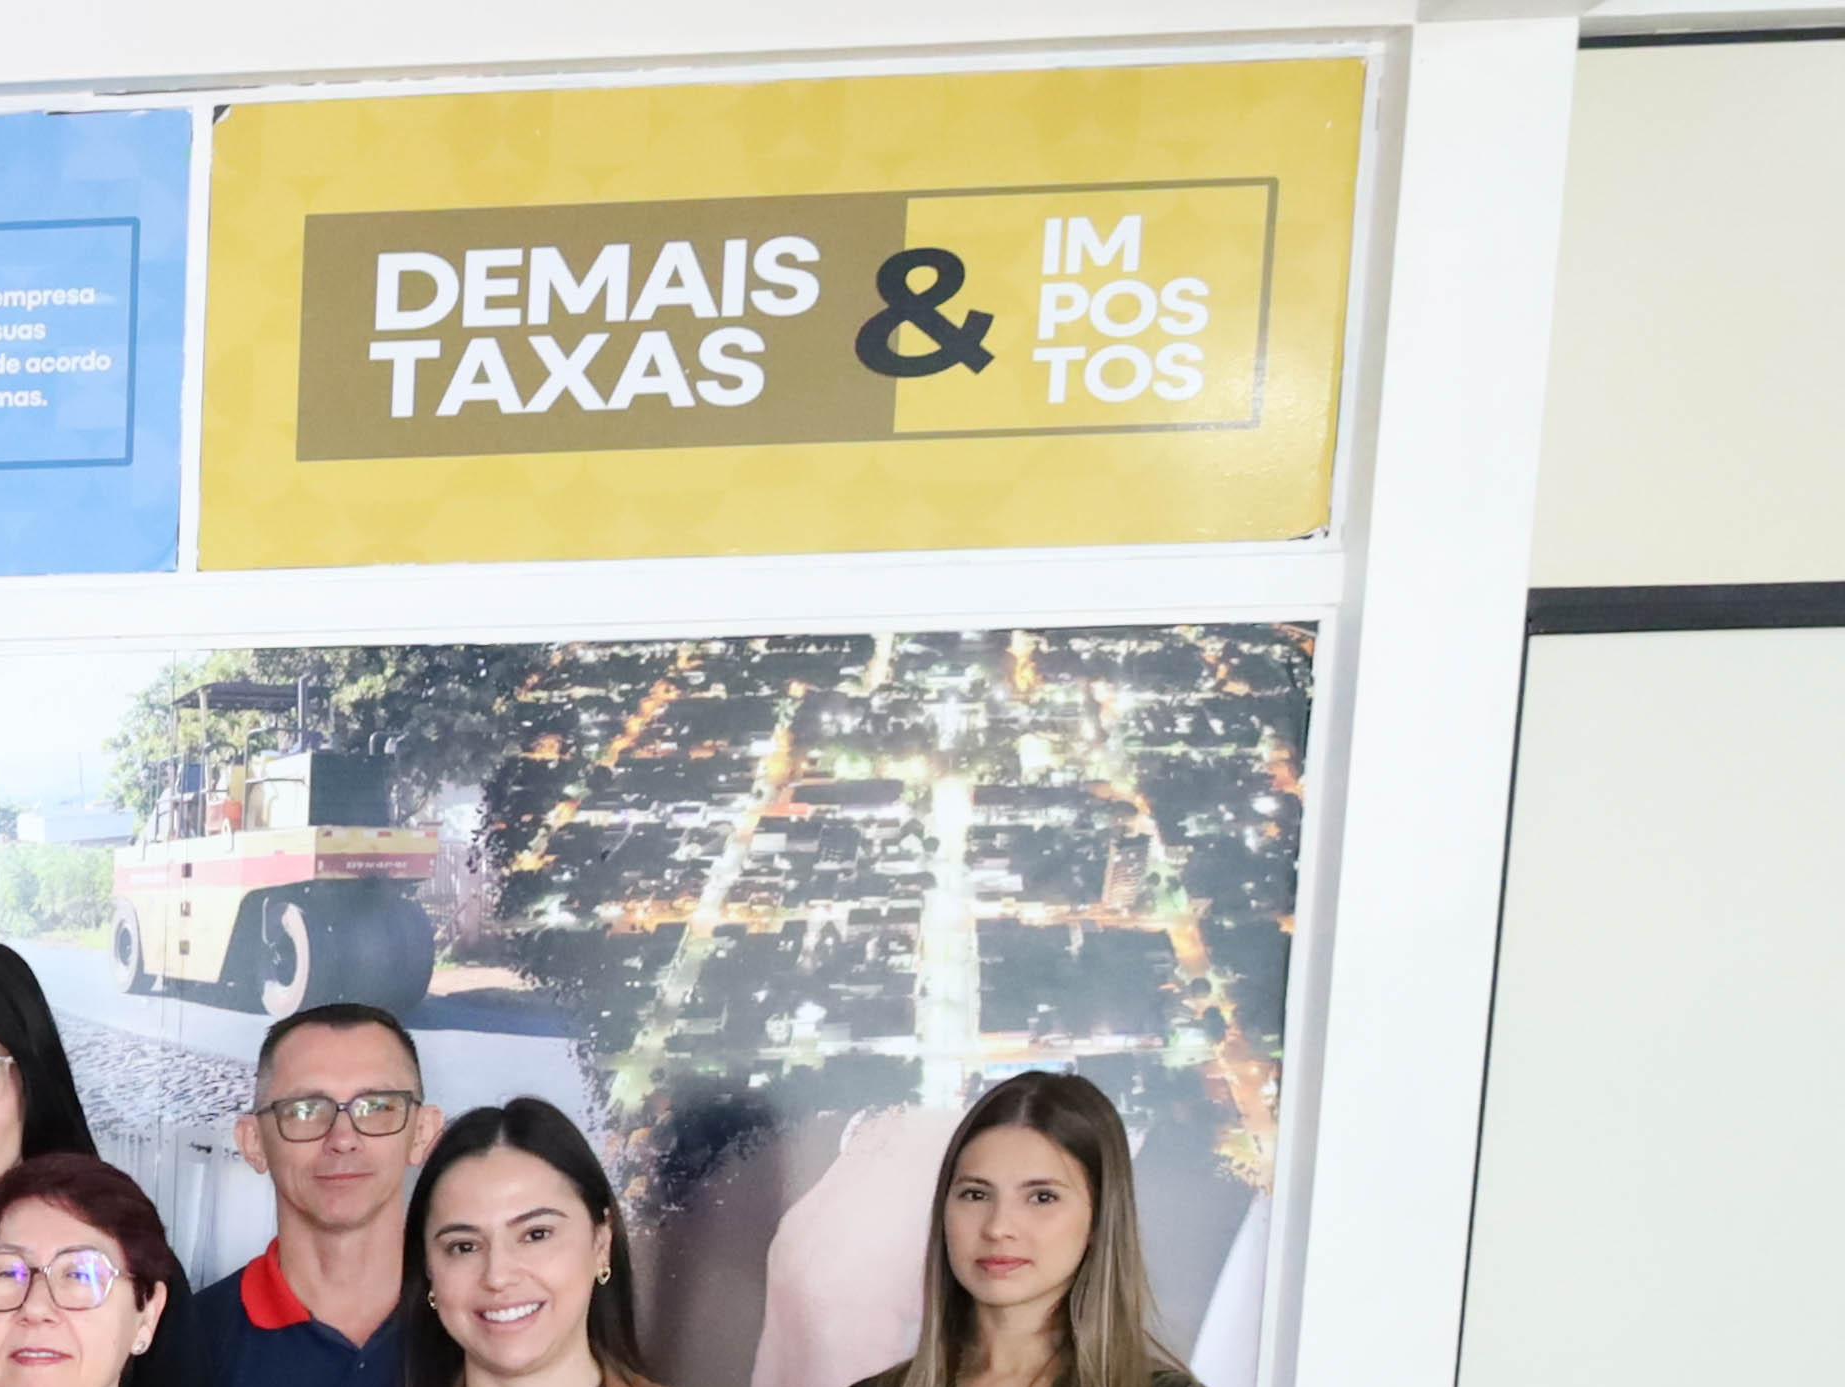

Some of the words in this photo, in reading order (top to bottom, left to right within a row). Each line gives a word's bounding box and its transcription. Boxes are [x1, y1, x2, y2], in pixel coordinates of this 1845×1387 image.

[1041, 215, 1143, 275] IM
[375, 236, 821, 332] DEMAIS
[854, 246, 995, 379] &
[1036, 275, 1209, 339] POS
[25, 350, 111, 373] acordo
[368, 330, 766, 419] TAXAS
[1032, 342, 1205, 404] TOS
